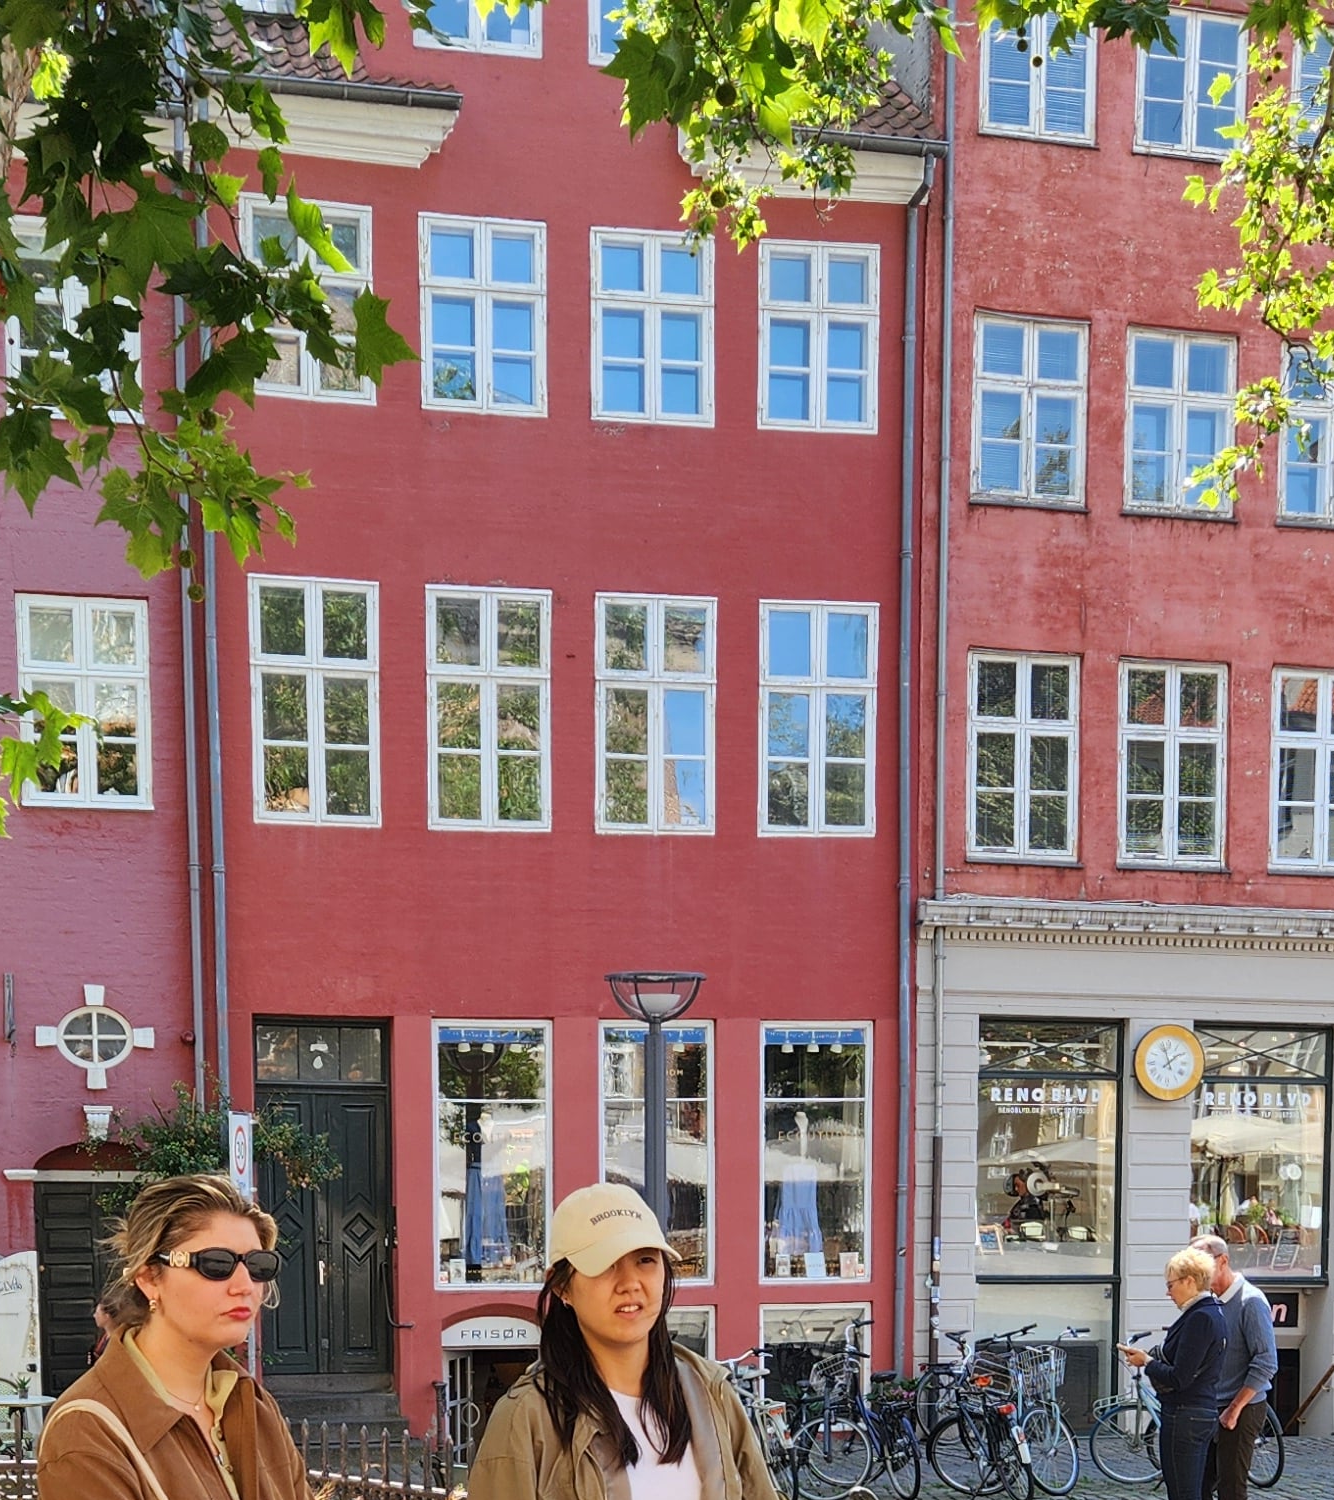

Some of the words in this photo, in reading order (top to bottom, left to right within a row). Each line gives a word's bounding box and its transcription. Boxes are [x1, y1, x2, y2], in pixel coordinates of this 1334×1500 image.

[990, 1087, 1045, 1102] RENO
[1052, 1088, 1102, 1102] BLVD
[1205, 1092, 1257, 1107] RENO
[1263, 1093, 1312, 1107] BLVD
[236, 1141, 245, 1160] 30
[590, 1209, 642, 1226] BROOKLYN
[460, 1328, 528, 1341] FRISØR
